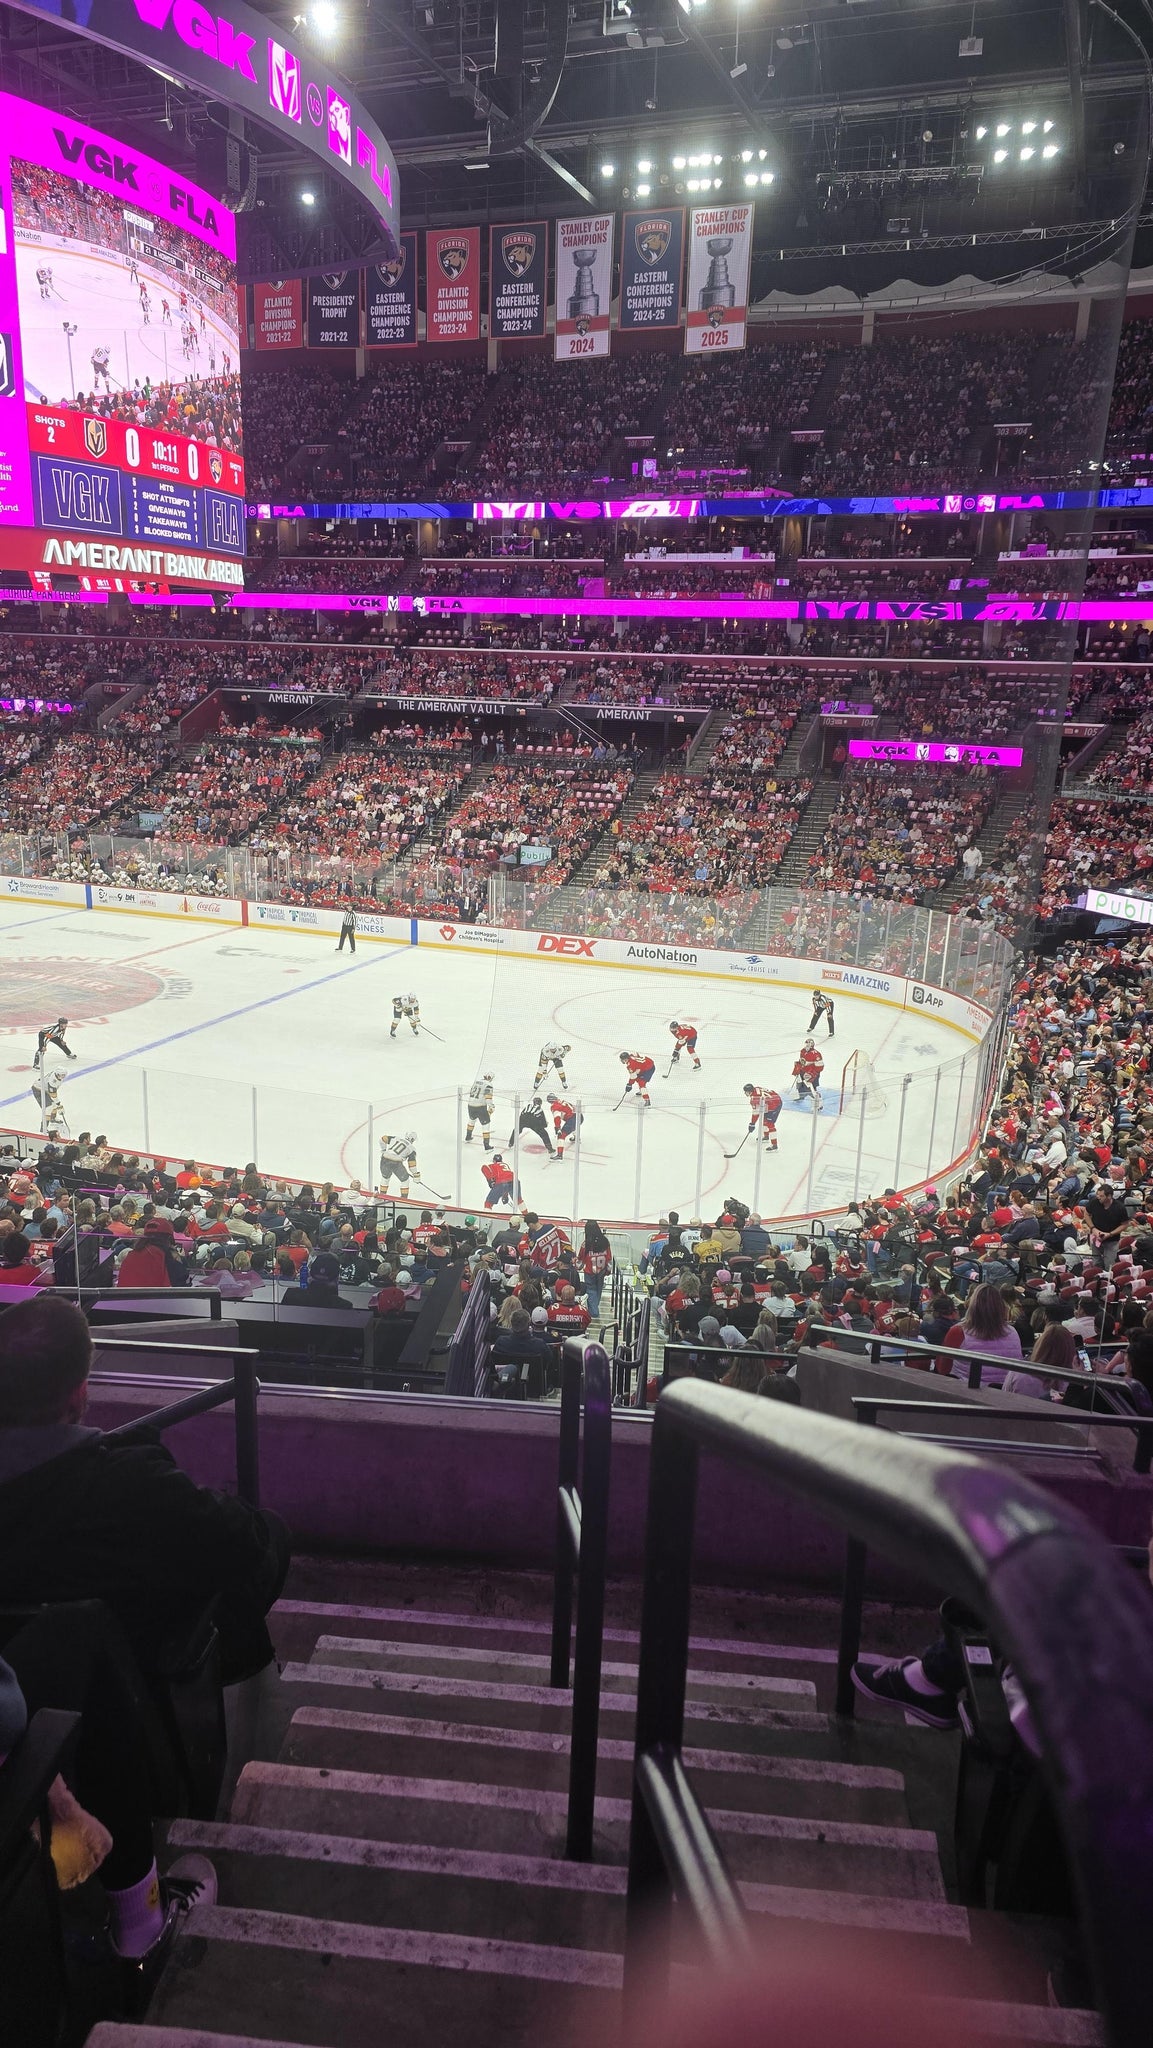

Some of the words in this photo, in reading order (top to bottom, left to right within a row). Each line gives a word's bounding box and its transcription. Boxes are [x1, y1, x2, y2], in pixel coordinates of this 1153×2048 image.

[133, 0, 258, 83] VGK
[357, 126, 392, 208] FLA
[53, 128, 139, 192] VGK
[169, 184, 219, 237] FLA
[695, 211, 730, 225] STANLEY
[732, 208, 749, 221] CUP
[560, 222, 592, 236] STANLEY
[594, 220, 610, 231] CUP
[639, 223, 668, 233] FLORIDA
[696, 222, 746, 237] CHAMPIONS
[440, 241, 466, 249] FLORIDA
[562, 232, 608, 247] CHAMPIONS
[634, 271, 668, 284] EASTERN
[437, 287, 470, 298] ATLANTIC
[502, 282, 534, 295] EASTERN
[626, 283, 675, 297] CONFERENCE
[263, 296, 293, 308] ATLANTIC
[312, 295, 356, 306] PRESIDENTS'
[376, 292, 405, 304] EASTERN
[438, 299, 468, 310] DIVISION
[496, 294, 540, 307] CONFERENCE
[627, 296, 673, 309] CHAMPIONS
[264, 308, 292, 320] DIVISION
[321, 308, 347, 318] TROPHY
[370, 304, 411, 316] CONFERENCE
[496, 307, 539, 319] CHAMPIONS
[633, 309, 665, 321] 2024-25
[371, 316, 410, 328] CHAMPIONS
[433, 311, 473, 323] CHAMPIONS
[260, 320, 297, 332] CHAMPIONS
[439, 323, 467, 334] 2023-24
[502, 320, 532, 331] 2023-24
[266, 332, 292, 343] 2021-22
[320, 331, 348, 342] 2021-22
[377, 328, 405, 339] 2022-23
[701, 330, 729, 347] 2025
[569, 338, 595, 354] 2024
[34, 415, 66, 428] SHOTS
[47, 426, 56, 443] 2
[125, 428, 140, 467] 0
[152, 440, 178, 464] 10:11
[187, 444, 199, 480] 0
[159, 483, 175, 493] HITS
[52, 468, 112, 524] VGK
[142, 491, 159, 502] SHOT
[160, 495, 191, 507] ATTEMPTS
[999, 496, 1045, 509] FLA
[133, 501, 138, 511] 2
[148, 504, 186, 518] GIVEAWAYS
[273, 506, 306, 516] FLA
[548, 501, 601, 518] VS
[147, 515, 188, 529] TAKEAWAYS
[211, 499, 240, 546] FLA
[144, 526, 172, 538] BLOCKED
[173, 530, 192, 541] SHOTS
[43, 538, 163, 574] AMERANT
[164, 552, 208, 580] BANK
[206, 559, 245, 586] ARENA
[348, 598, 383, 607] VGK
[429, 600, 463, 609] FLA
[887, 603, 951, 619] VS
[268, 693, 315, 705] AMERANT
[397, 700, 415, 710] THE
[417, 701, 468, 713] AMERANT
[470, 703, 507, 715] VAULT
[596, 708, 652, 720] AMERANT
[1084, 727, 1098, 737] 105
[870, 745, 910, 756] VGK
[1096, 893, 1153, 922] Publi
[354, 915, 385, 924] MCAST
[355, 925, 385, 934] SINESS
[537, 934, 599, 957] DEX
[627, 945, 698, 963] AutoNation
[843, 972, 890, 992] AMAZING
[469, 1086, 481, 1099] 21
[388, 1140, 407, 1156] 10
[541, 1238, 561, 1265] 27
